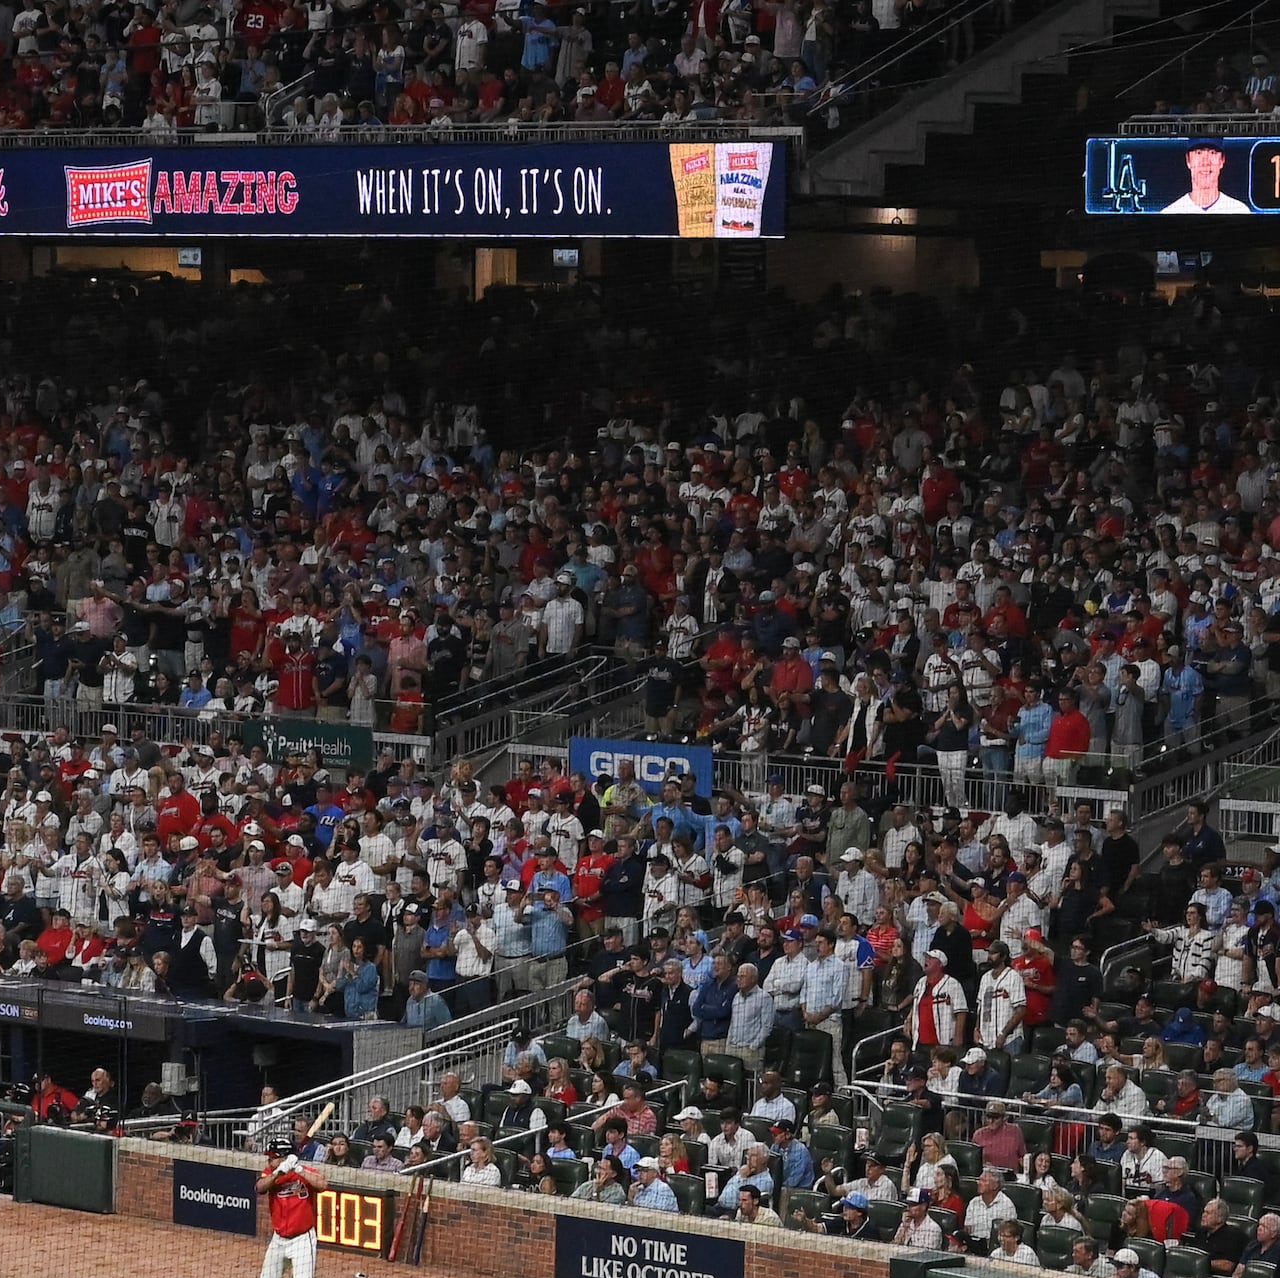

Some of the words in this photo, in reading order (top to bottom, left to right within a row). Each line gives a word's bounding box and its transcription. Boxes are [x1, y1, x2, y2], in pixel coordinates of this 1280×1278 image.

[246, 13, 264, 29] 23
[78, 179, 142, 211] MIKE'S
[153, 170, 299, 215] AMAZING
[356, 168, 413, 216] WHEN
[422, 168, 465, 215] IT'S
[474, 167, 511, 219] ON,
[520, 167, 563, 215] IT'S
[573, 167, 613, 215] ON.
[180, 1185, 251, 1211] Booking.com
[611, 1234, 638, 1258] NO
[641, 1239, 688, 1266] TIME
